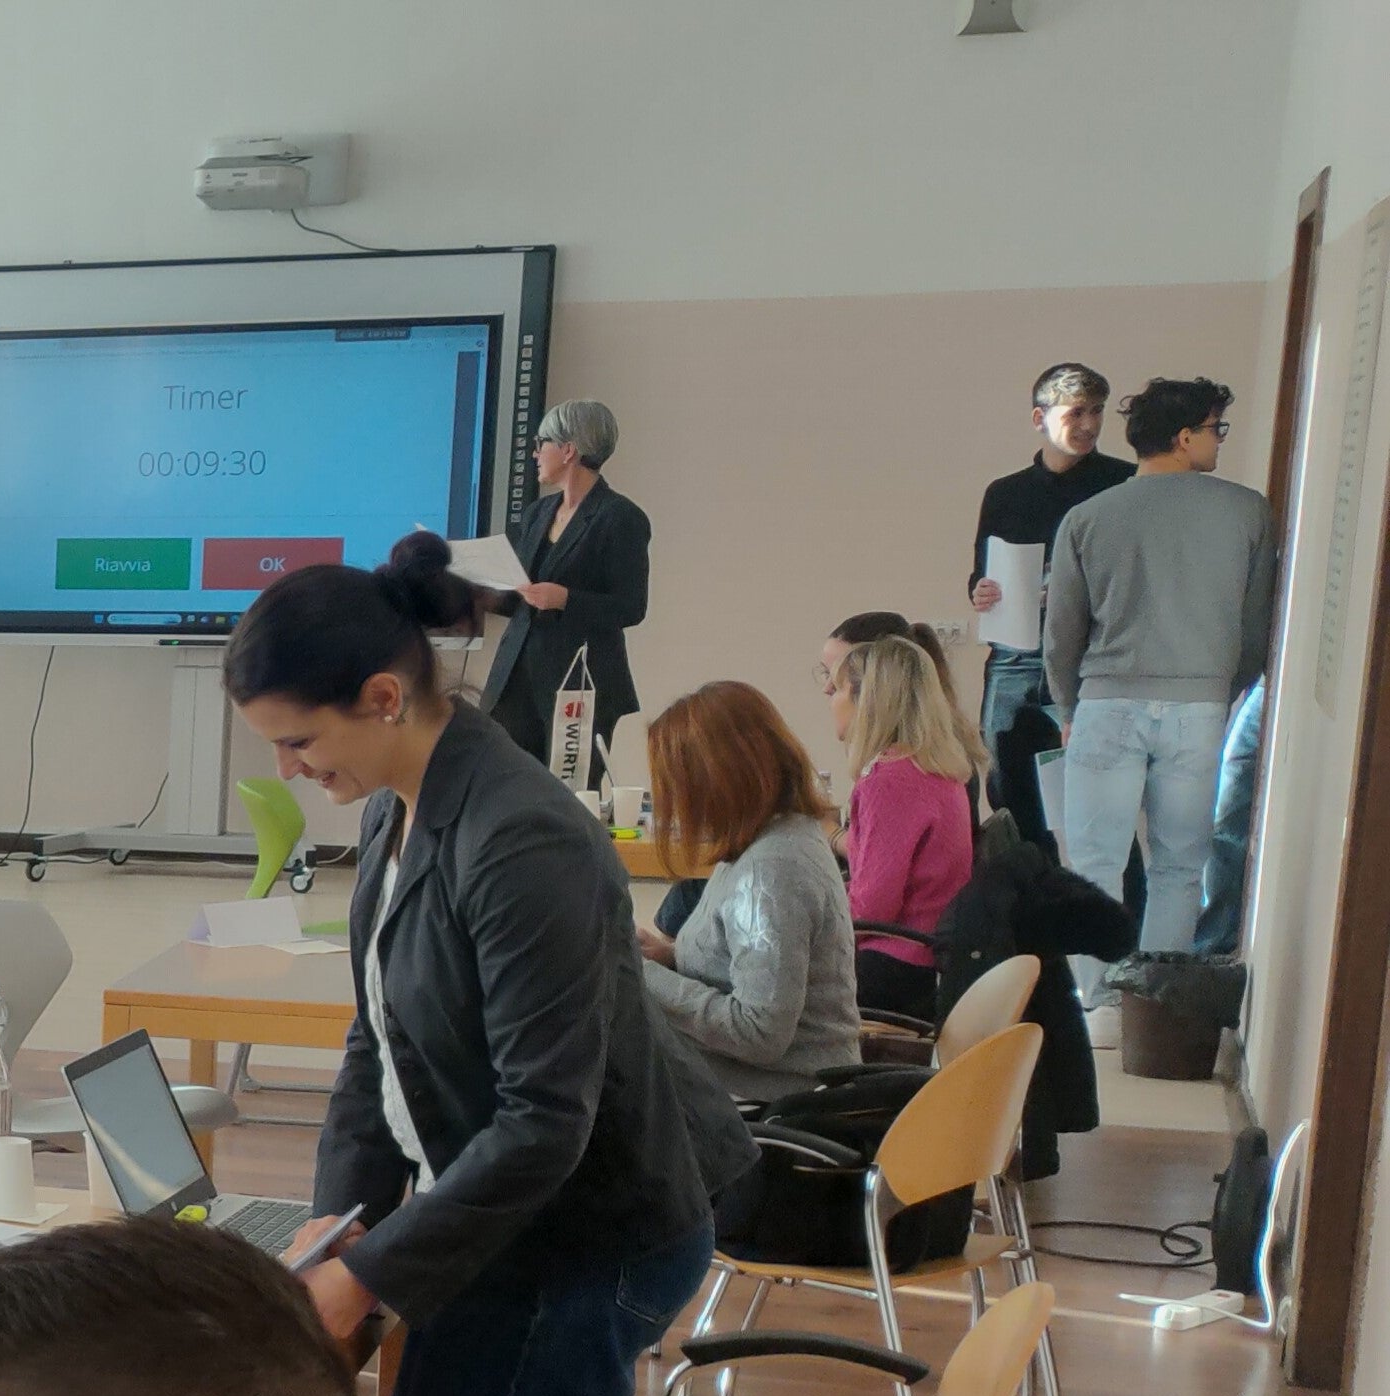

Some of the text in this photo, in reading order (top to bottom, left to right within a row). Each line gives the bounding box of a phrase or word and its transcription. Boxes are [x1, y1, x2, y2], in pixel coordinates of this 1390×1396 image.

[163, 385, 249, 410] Timer
[138, 450, 267, 477] 00:09:30
[94, 557, 152, 572] Riavvia
[259, 557, 287, 572] OK
